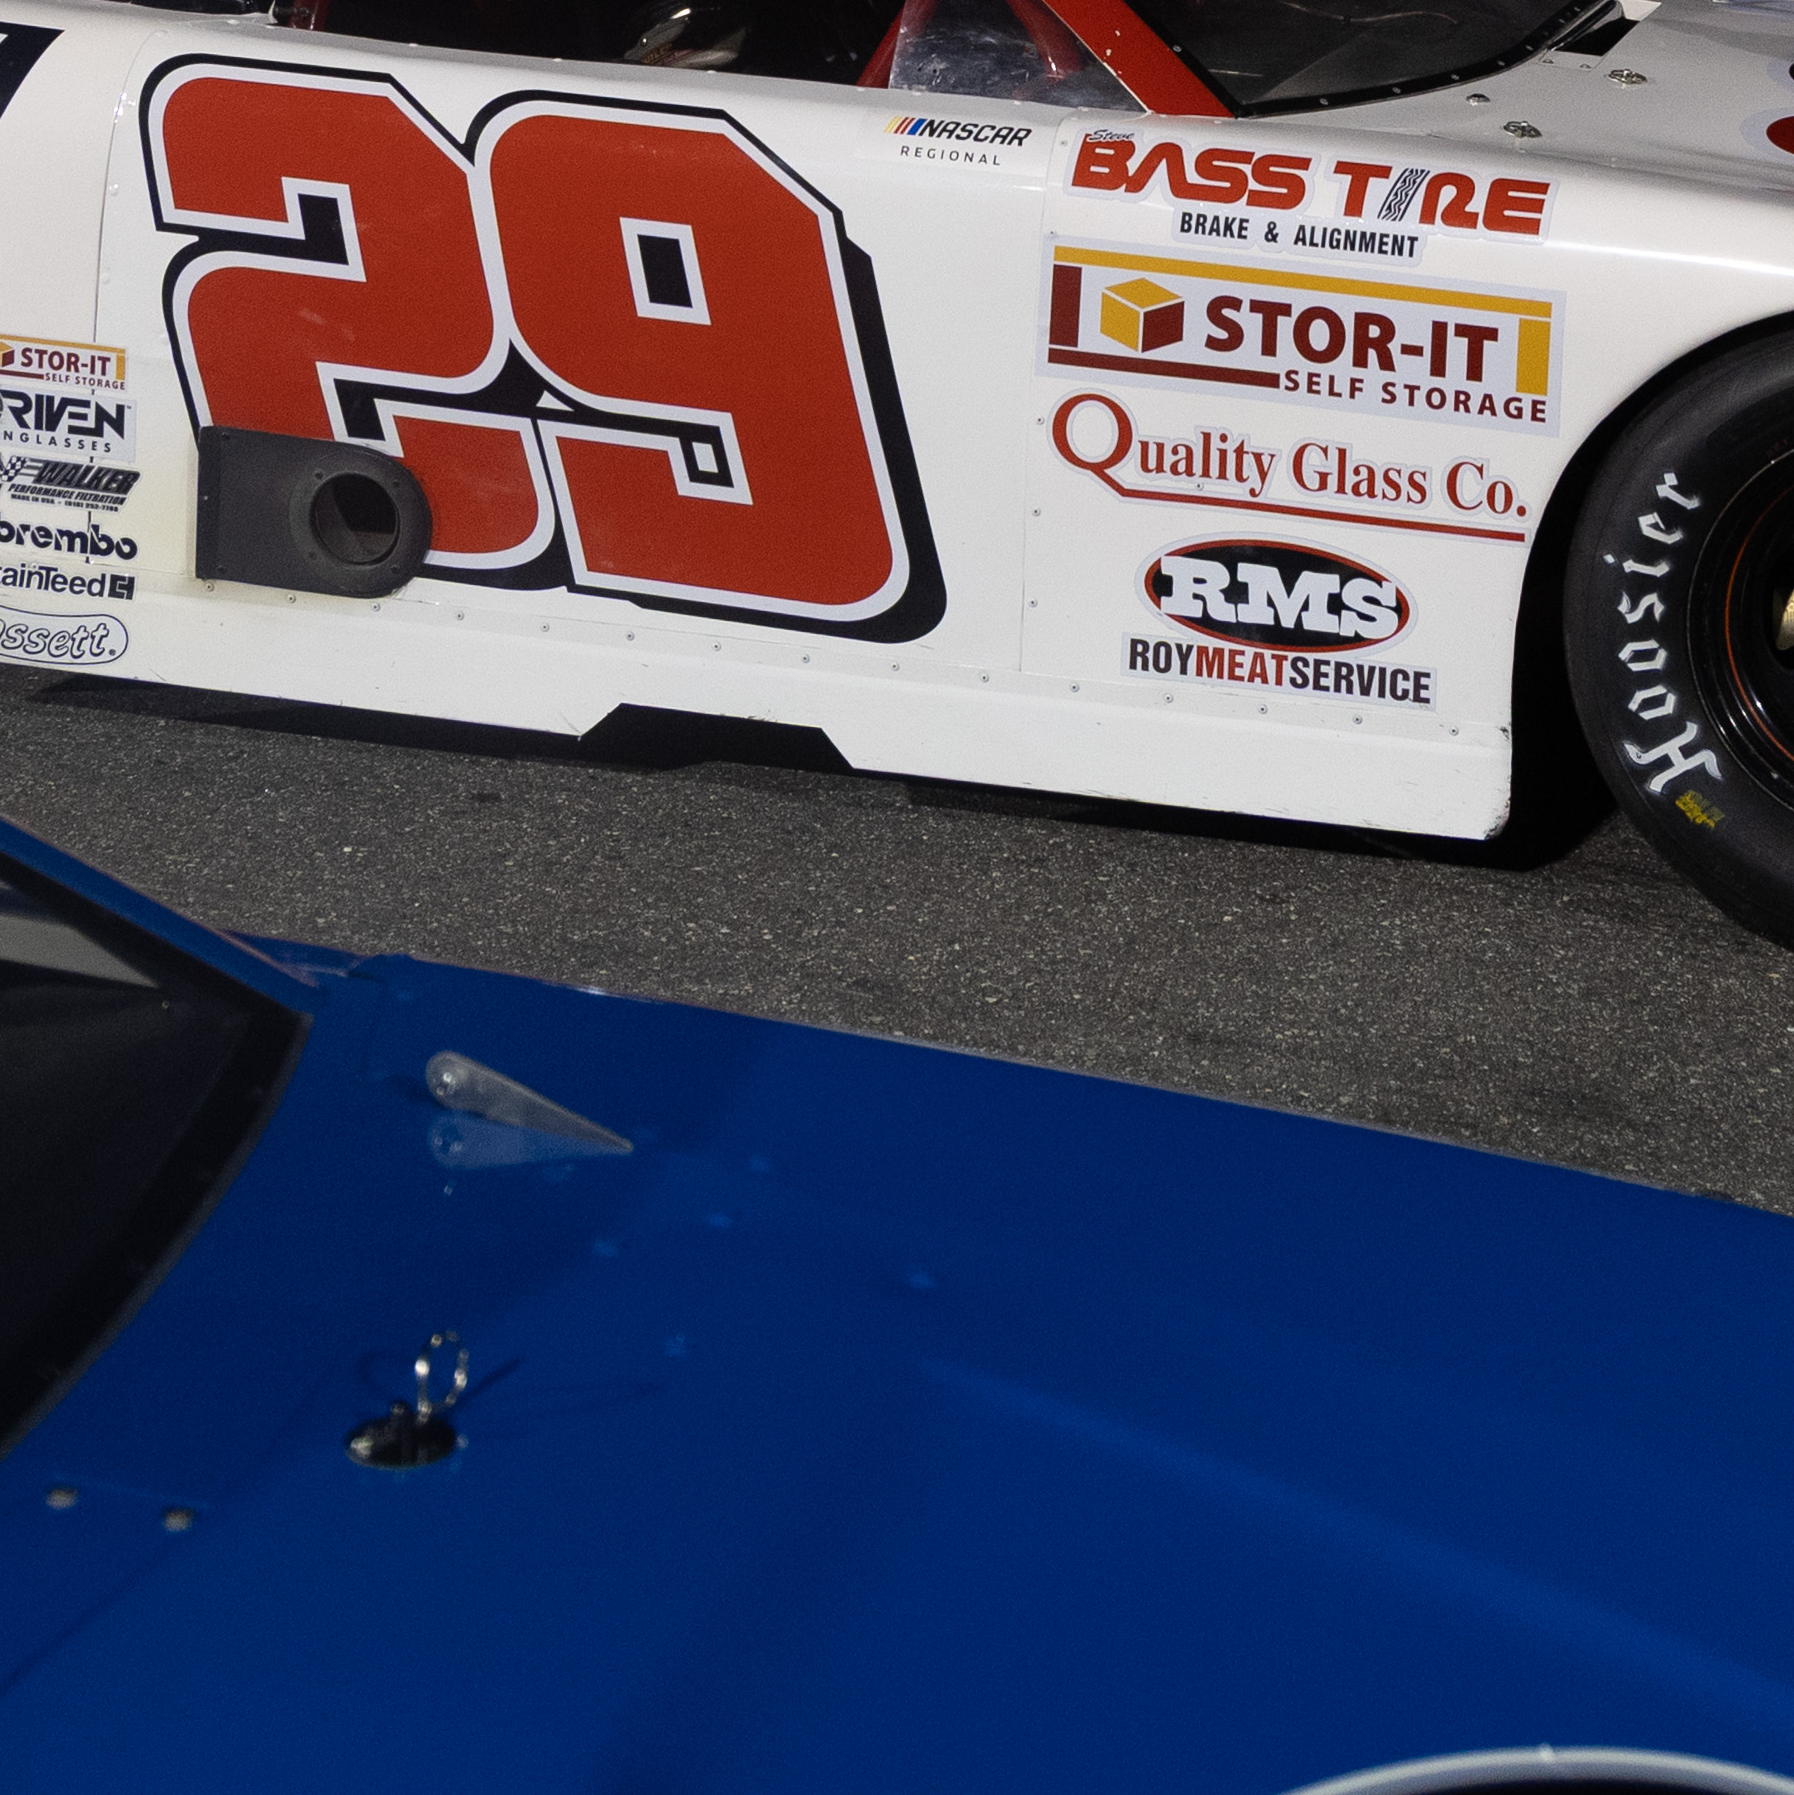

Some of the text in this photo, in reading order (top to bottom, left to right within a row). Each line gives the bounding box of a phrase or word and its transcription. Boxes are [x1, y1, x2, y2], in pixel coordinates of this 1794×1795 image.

[900, 145, 1001, 167] REGIONAL
[921, 117, 1032, 149] NASCAR
[1071, 137, 1312, 211] BASS
[1180, 211, 1419, 259] BRAKE & ALIGNMENT
[21, 347, 111, 377] STOR-IT
[145, 59, 933, 638] 29
[1204, 295, 1499, 383] STOR-IT
[45, 372, 126, 391] SELF STORAGE
[1284, 367, 1548, 424] SELF STORAGE
[38, 462, 140, 495] WALKER
[1051, 393, 1528, 518] Quality Glass Co.
[8, 483, 127, 506] PERFORMANCE FILTRATION
[1160, 556, 1400, 641] RMS
[1603, 471, 1725, 796] Hoosier
[1129, 638, 1431, 704] ROYMEATSERVICE
